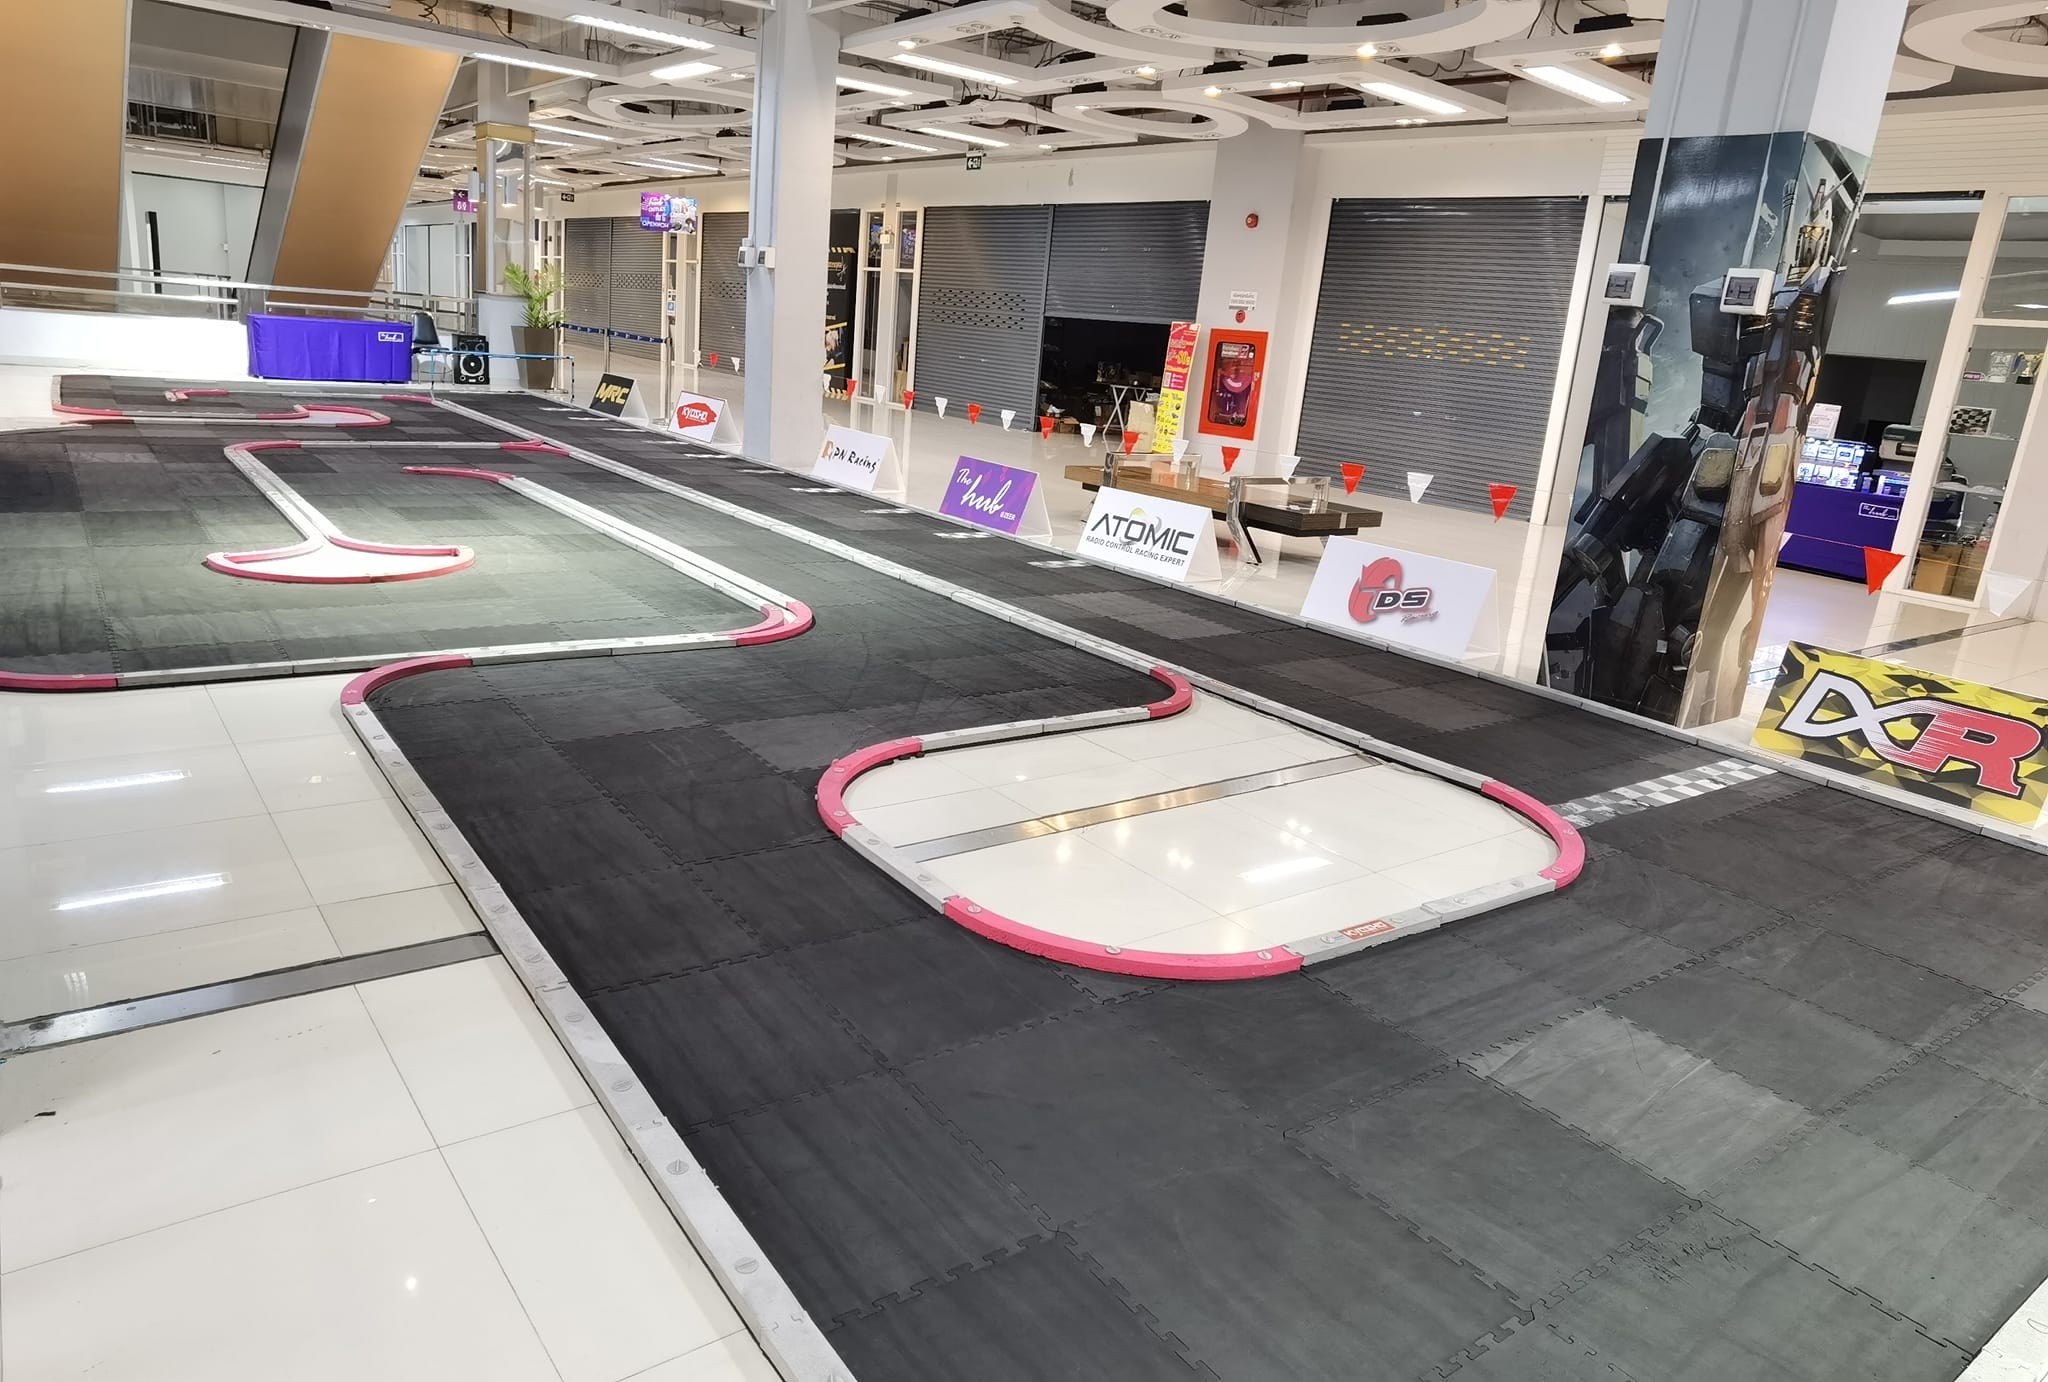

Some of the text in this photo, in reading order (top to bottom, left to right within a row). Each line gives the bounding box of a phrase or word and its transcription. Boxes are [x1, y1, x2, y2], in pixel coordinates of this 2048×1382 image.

[596, 382, 630, 405] MRC
[681, 406, 708, 421] KYOSHO
[832, 446, 877, 474] PN Racing
[956, 468, 973, 486] The
[960, 474, 1012, 515] hub
[1091, 513, 1195, 555] ATOMIC
[1086, 535, 1185, 566] RADIO CONTROL RACING EXPERT
[1775, 668, 2042, 800] DXR
